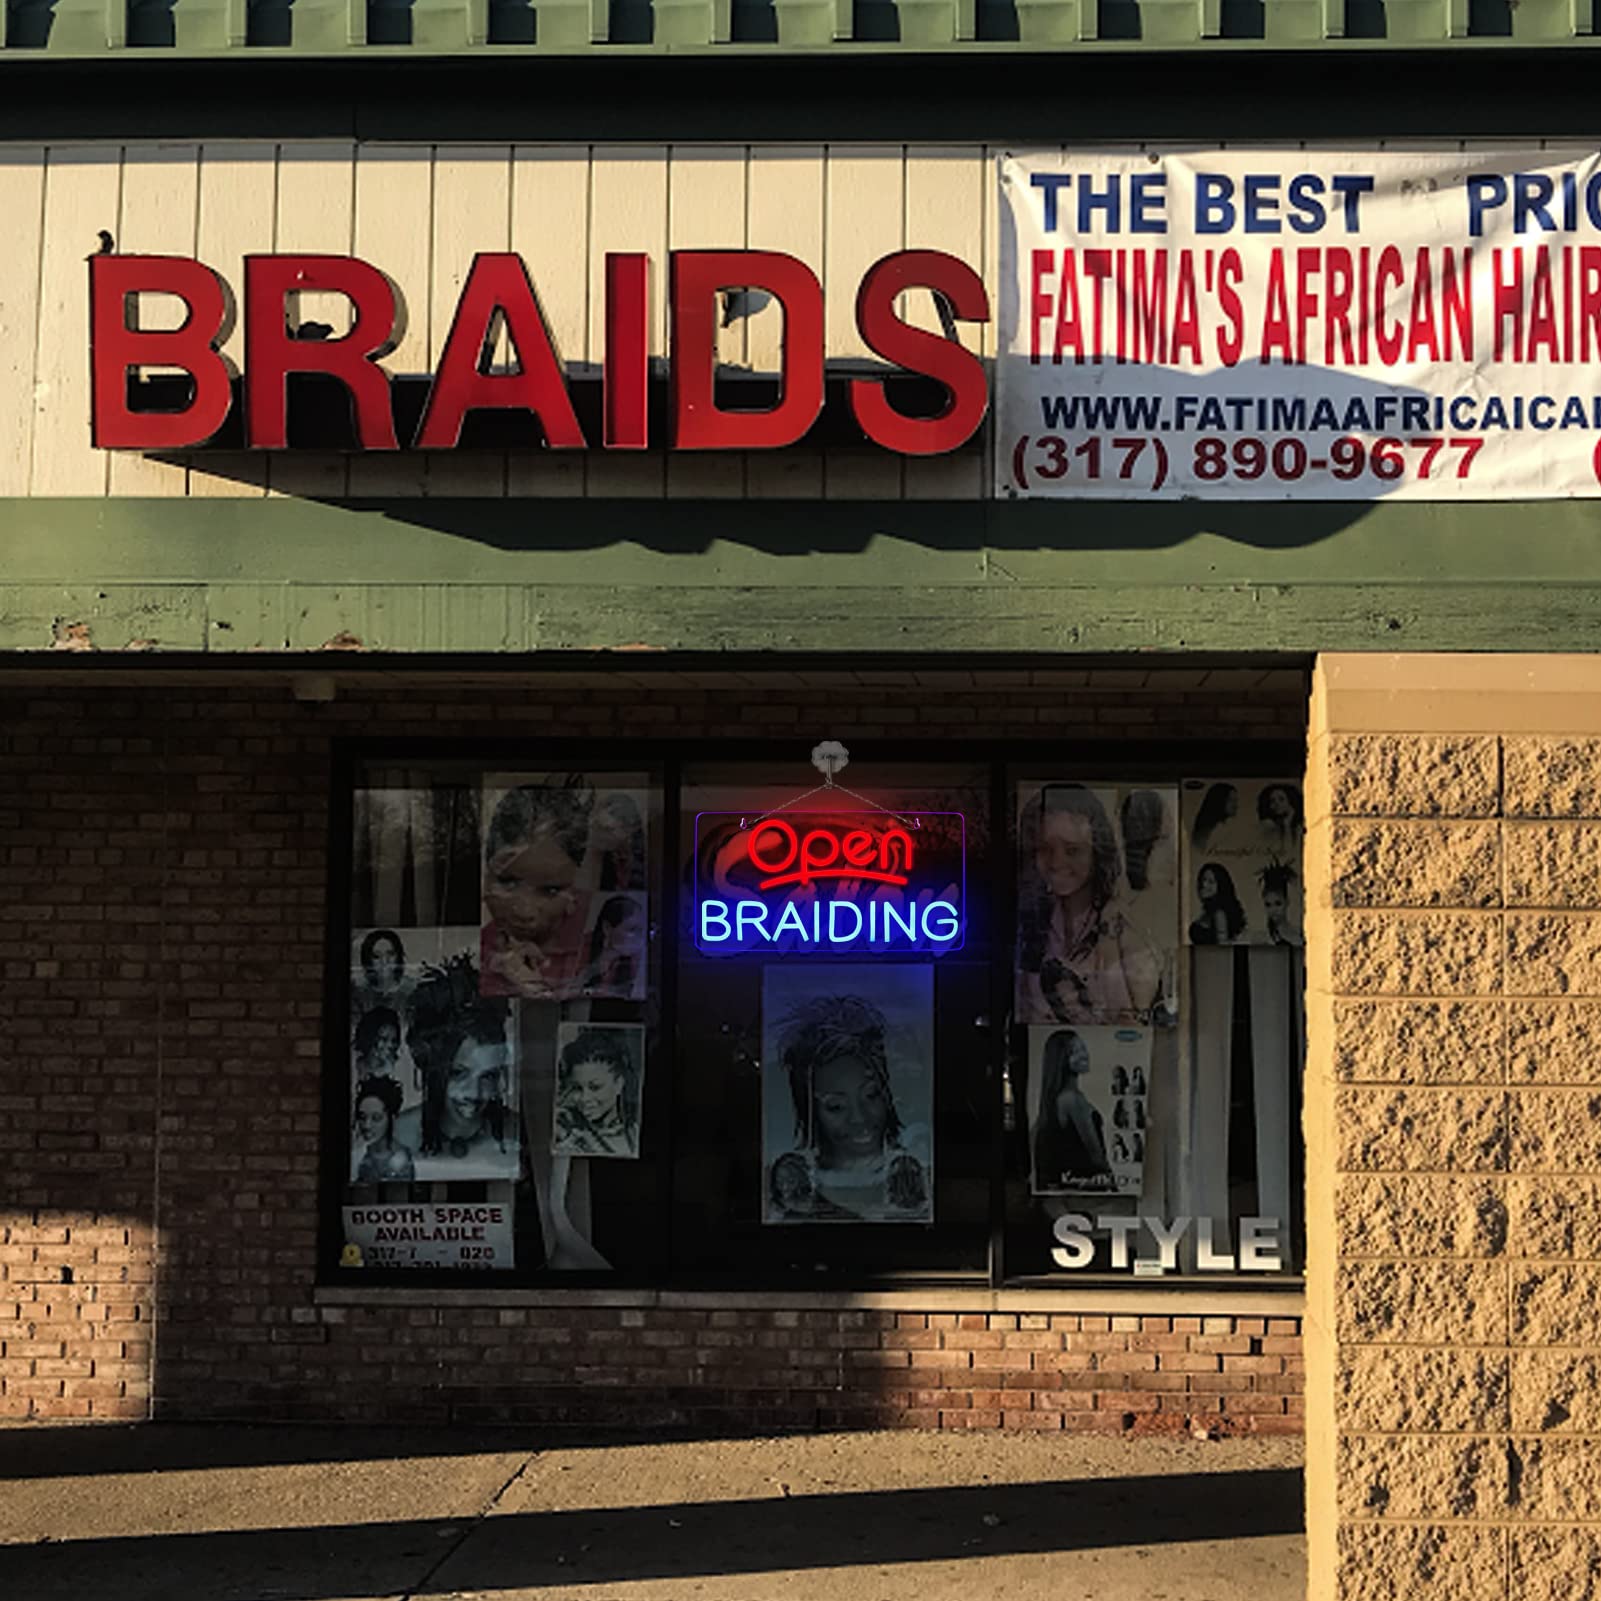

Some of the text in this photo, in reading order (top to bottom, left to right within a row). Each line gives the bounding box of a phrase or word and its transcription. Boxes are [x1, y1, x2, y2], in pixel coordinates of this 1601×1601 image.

[1030, 173, 1168, 234] THE
[1195, 174, 1374, 235] BEST
[1030, 245, 1601, 367] FATIMA'S AFRICAN HAIR
[89, 249, 991, 455] BRAIDS
[1042, 396, 1601, 432] WWW.FATIMAAFRICAICA
[1013, 436, 1485, 490] (317) 890-9677
[748, 818, 913, 887] Open
[701, 900, 960, 944] BRAIDING
[374, 1227, 485, 1241] AVAILABLE
[435, 1208, 503, 1224] SPACE
[1051, 1213, 1282, 1271] STYLE
